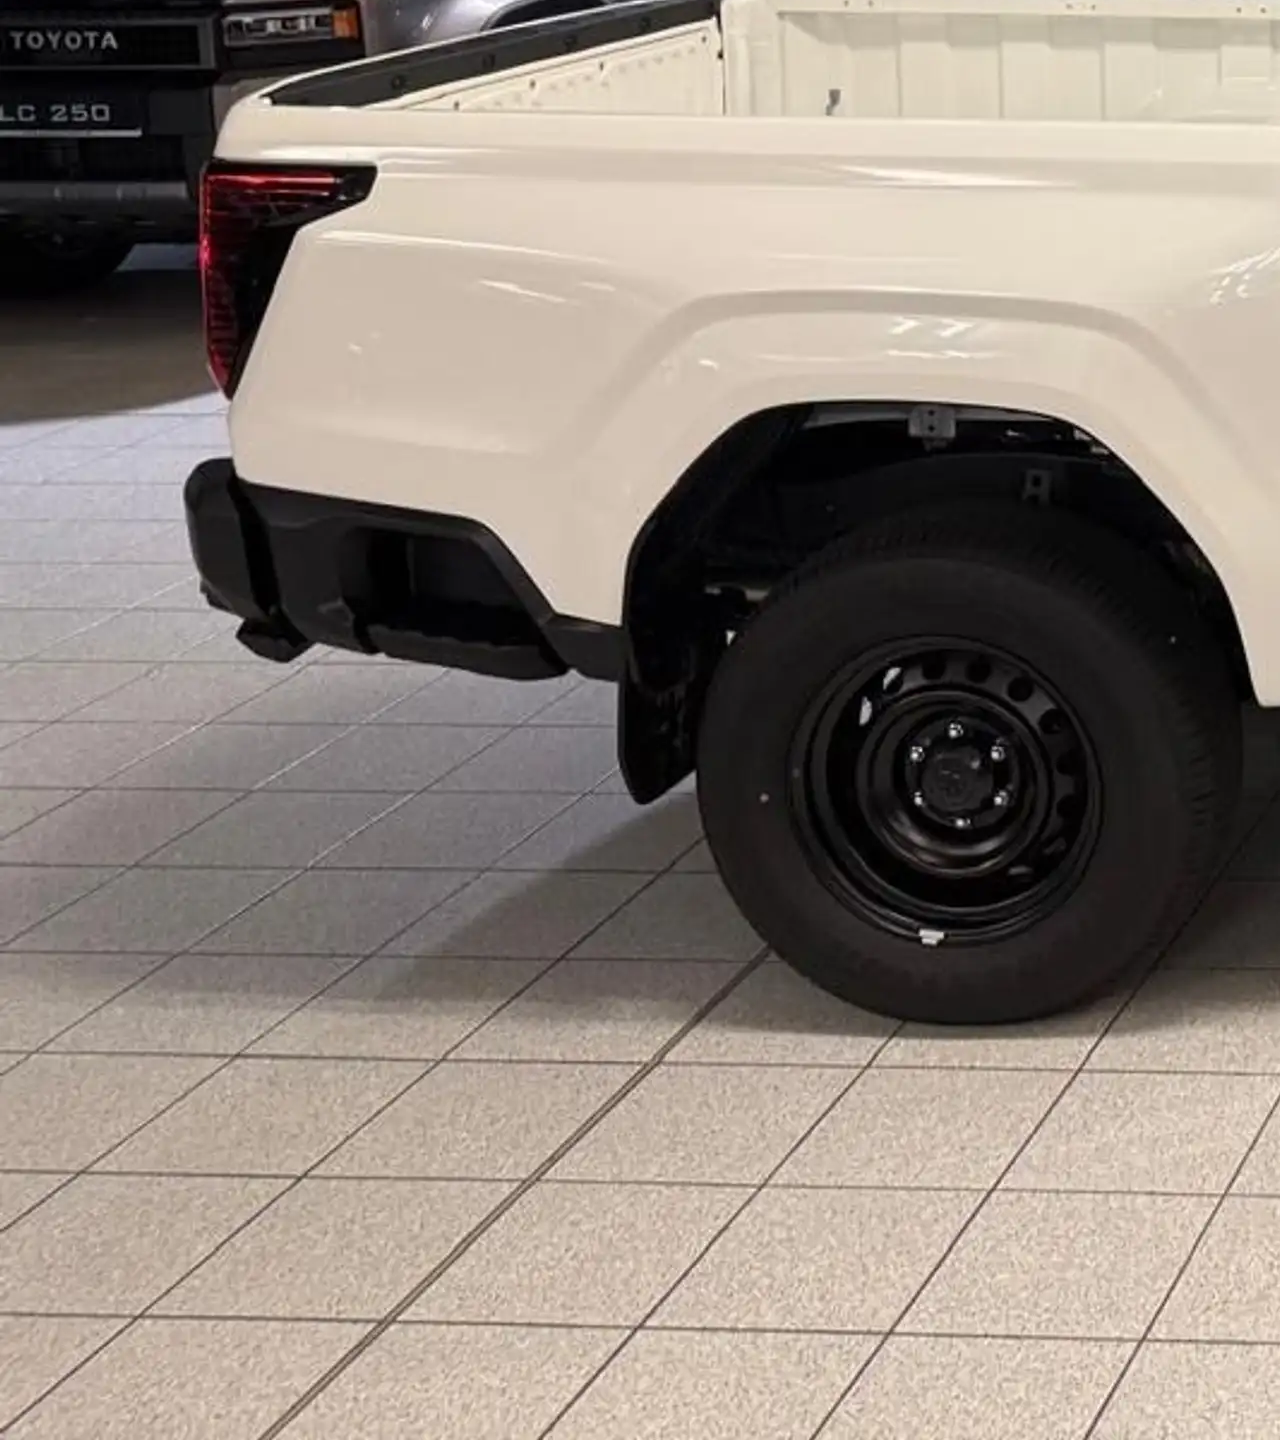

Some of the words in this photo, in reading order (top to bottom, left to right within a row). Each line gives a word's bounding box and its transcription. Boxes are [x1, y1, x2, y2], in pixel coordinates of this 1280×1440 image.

[9, 29, 119, 51] TOYOTA
[0, 103, 36, 122] LC
[49, 103, 111, 122] 250
